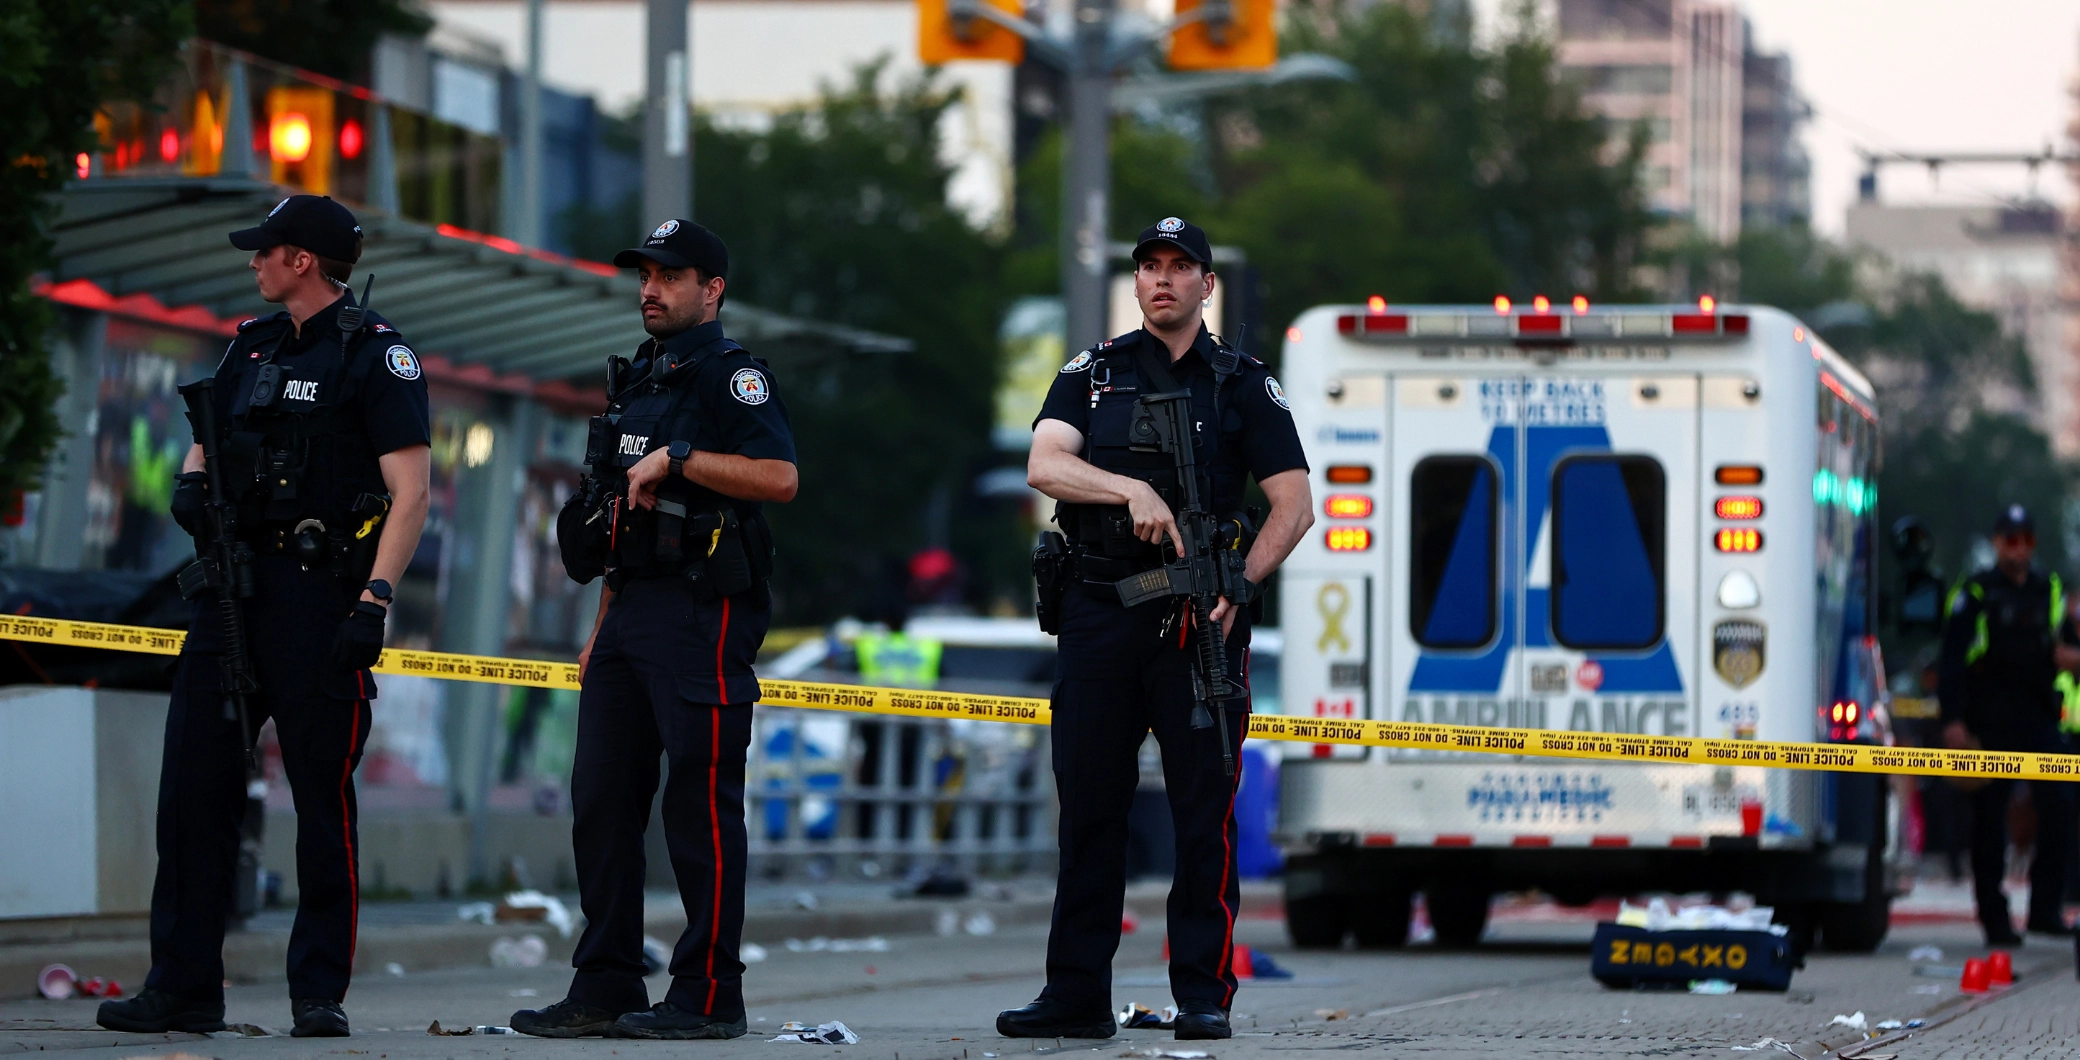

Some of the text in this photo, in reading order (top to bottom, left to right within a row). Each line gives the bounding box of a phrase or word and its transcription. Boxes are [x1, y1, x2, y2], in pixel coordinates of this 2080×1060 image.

[283, 380, 318, 401] POLICE
[1481, 381, 1604, 396] KEEP BACK
[619, 433, 649, 456] POLICE
[13, 624, 53, 637] POLICE
[72, 630, 175, 649] LINE- DO NOT CROSS
[402, 659, 548, 682] POLICE LINE- DO NOT CROSS
[763, 689, 873, 707] POLICE LINE- DO NOT
[891, 699, 1036, 719] POLICE LINE- DO NOT CROSS
[1250, 723, 1361, 739] POLICE LINE- DO NOT
[1379, 730, 1524, 749] POLICE LINE- DO NOT CROSS
[1543, 740, 1689, 758] POLICE LINE- DO NOT CROSS
[1707, 748, 1854, 766] POLICE LINE- DO NOT CROSS
[1872, 757, 2021, 773] POLICE LINE- DO NOT CROSS
[2039, 764, 2071, 773] CROSS
[1608, 939, 1748, 970] OXYGEN
